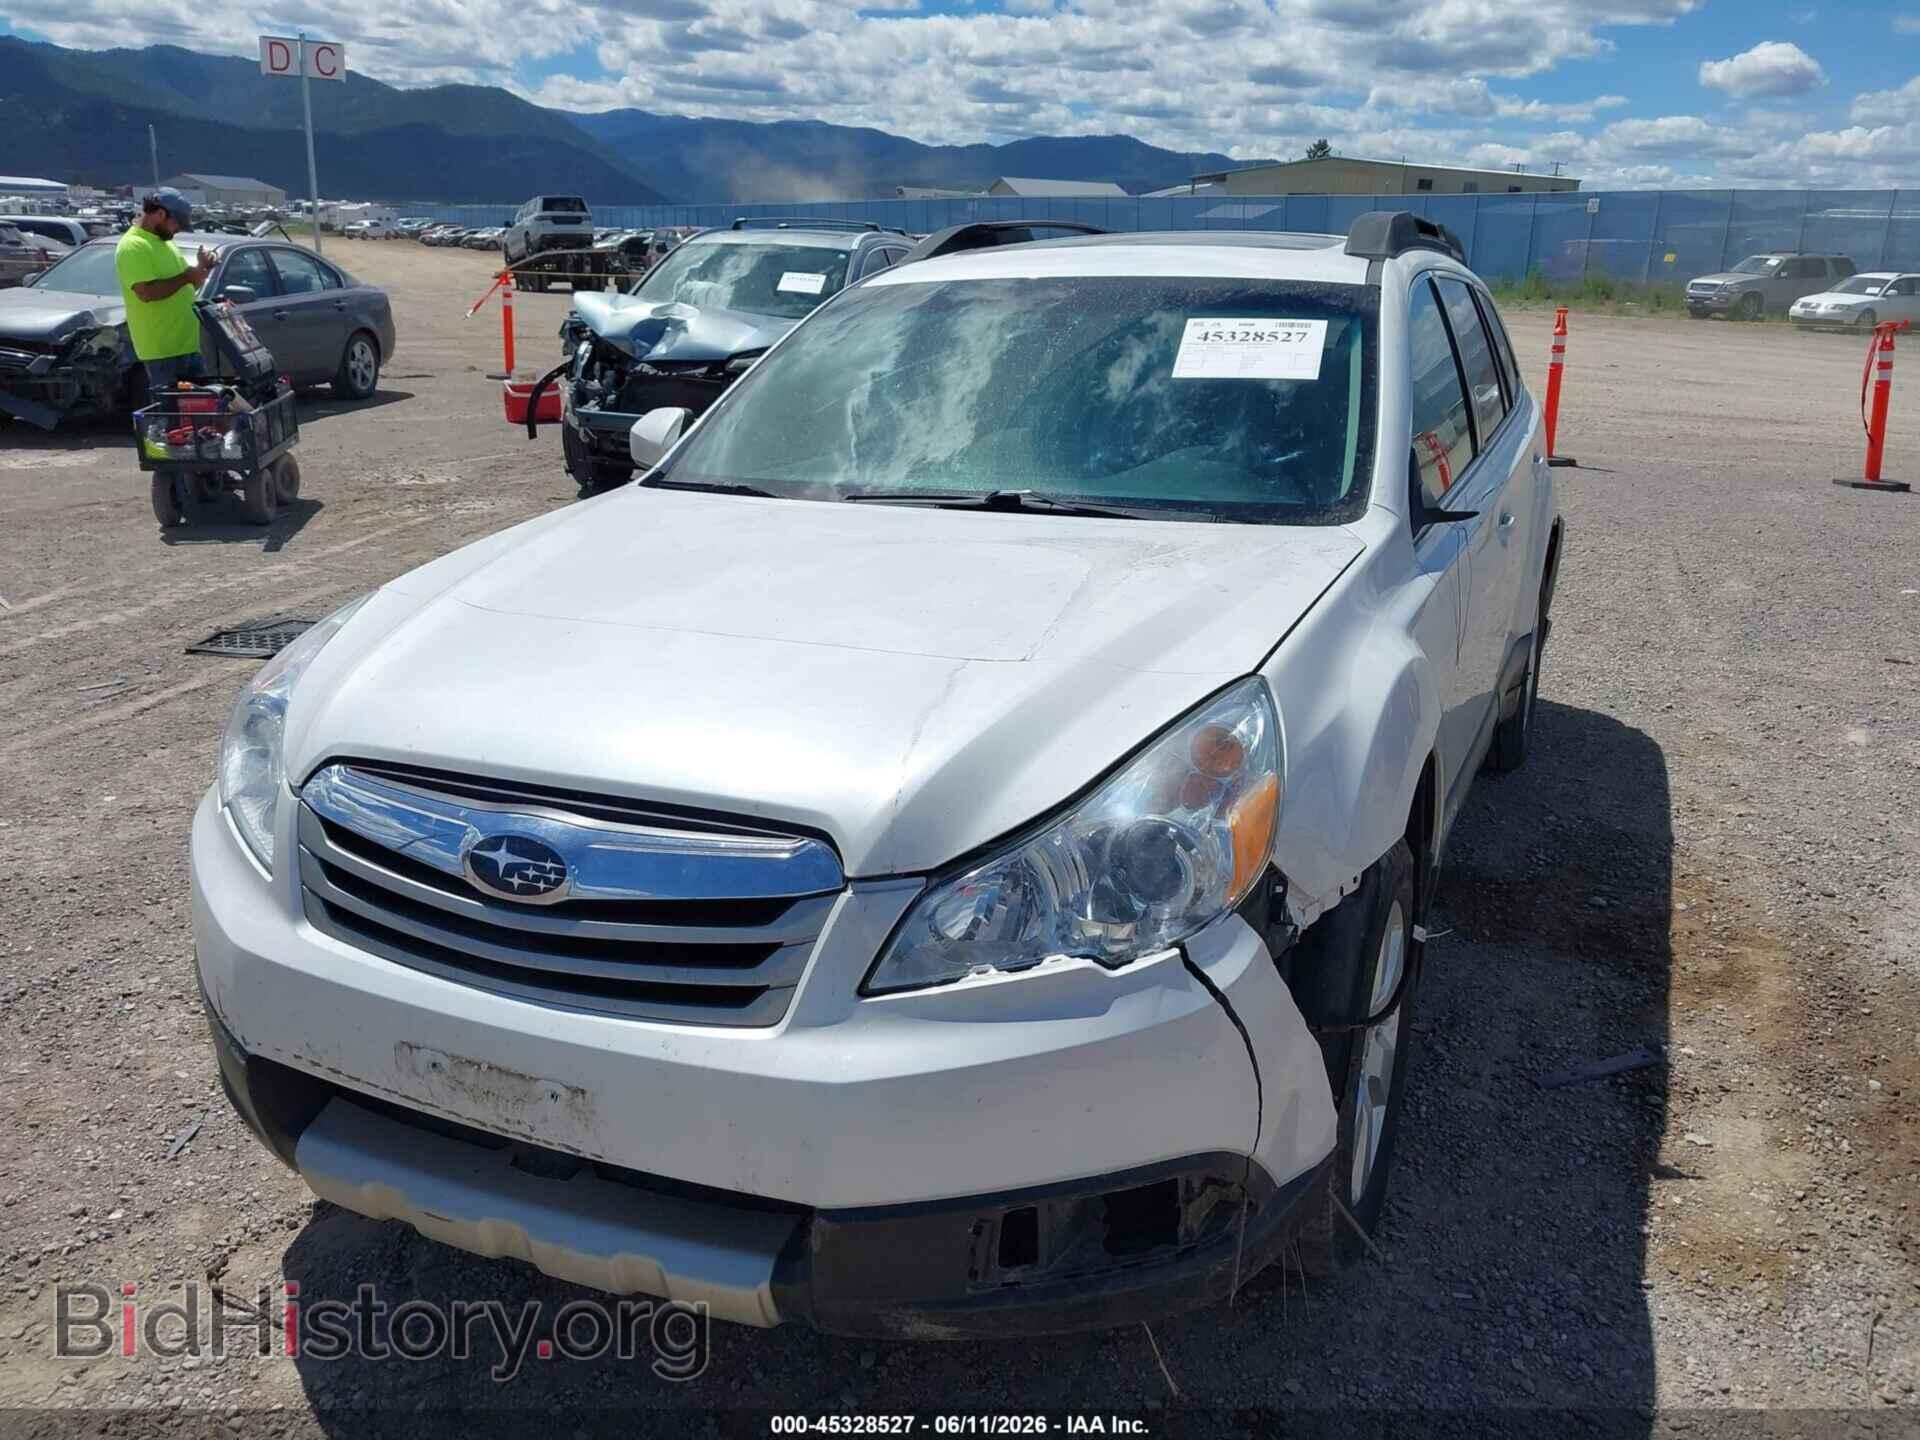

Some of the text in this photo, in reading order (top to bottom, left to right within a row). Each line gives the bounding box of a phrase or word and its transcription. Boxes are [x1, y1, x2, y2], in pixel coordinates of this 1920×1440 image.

[269, 41, 290, 71] D
[315, 46, 336, 77] C
[1196, 331, 1308, 343] 45328527
